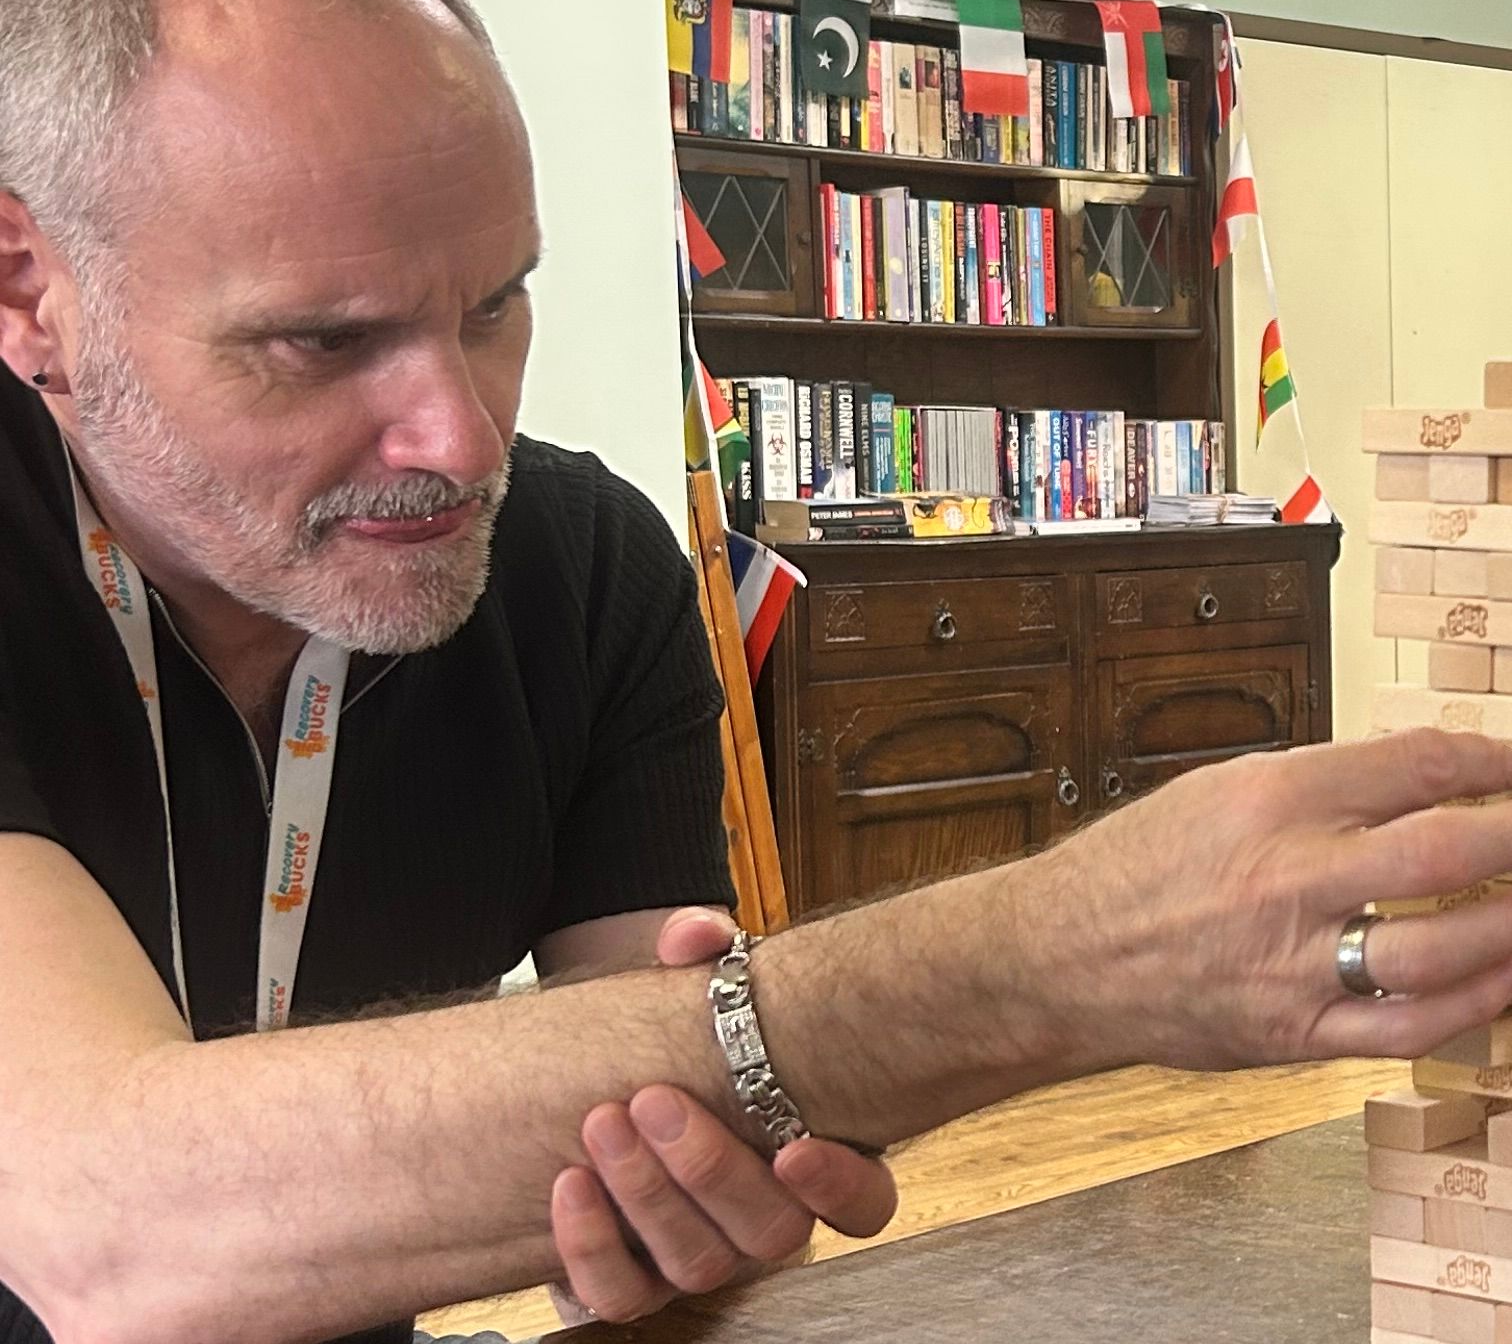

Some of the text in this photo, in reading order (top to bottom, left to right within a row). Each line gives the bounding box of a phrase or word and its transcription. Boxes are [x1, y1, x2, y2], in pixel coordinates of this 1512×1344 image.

[838, 394, 855, 460] CORNWELL
[861, 428, 870, 456] ELMS
[1127, 433, 1137, 481] DEAVER
[1420, 414, 1461, 449] Jenga
[799, 440, 813, 485] OSMAN
[294, 674, 321, 742] Recovery
[309, 683, 332, 754] BUCKS
[277, 823, 300, 896] Recovery
[290, 831, 311, 907] BUCKS
